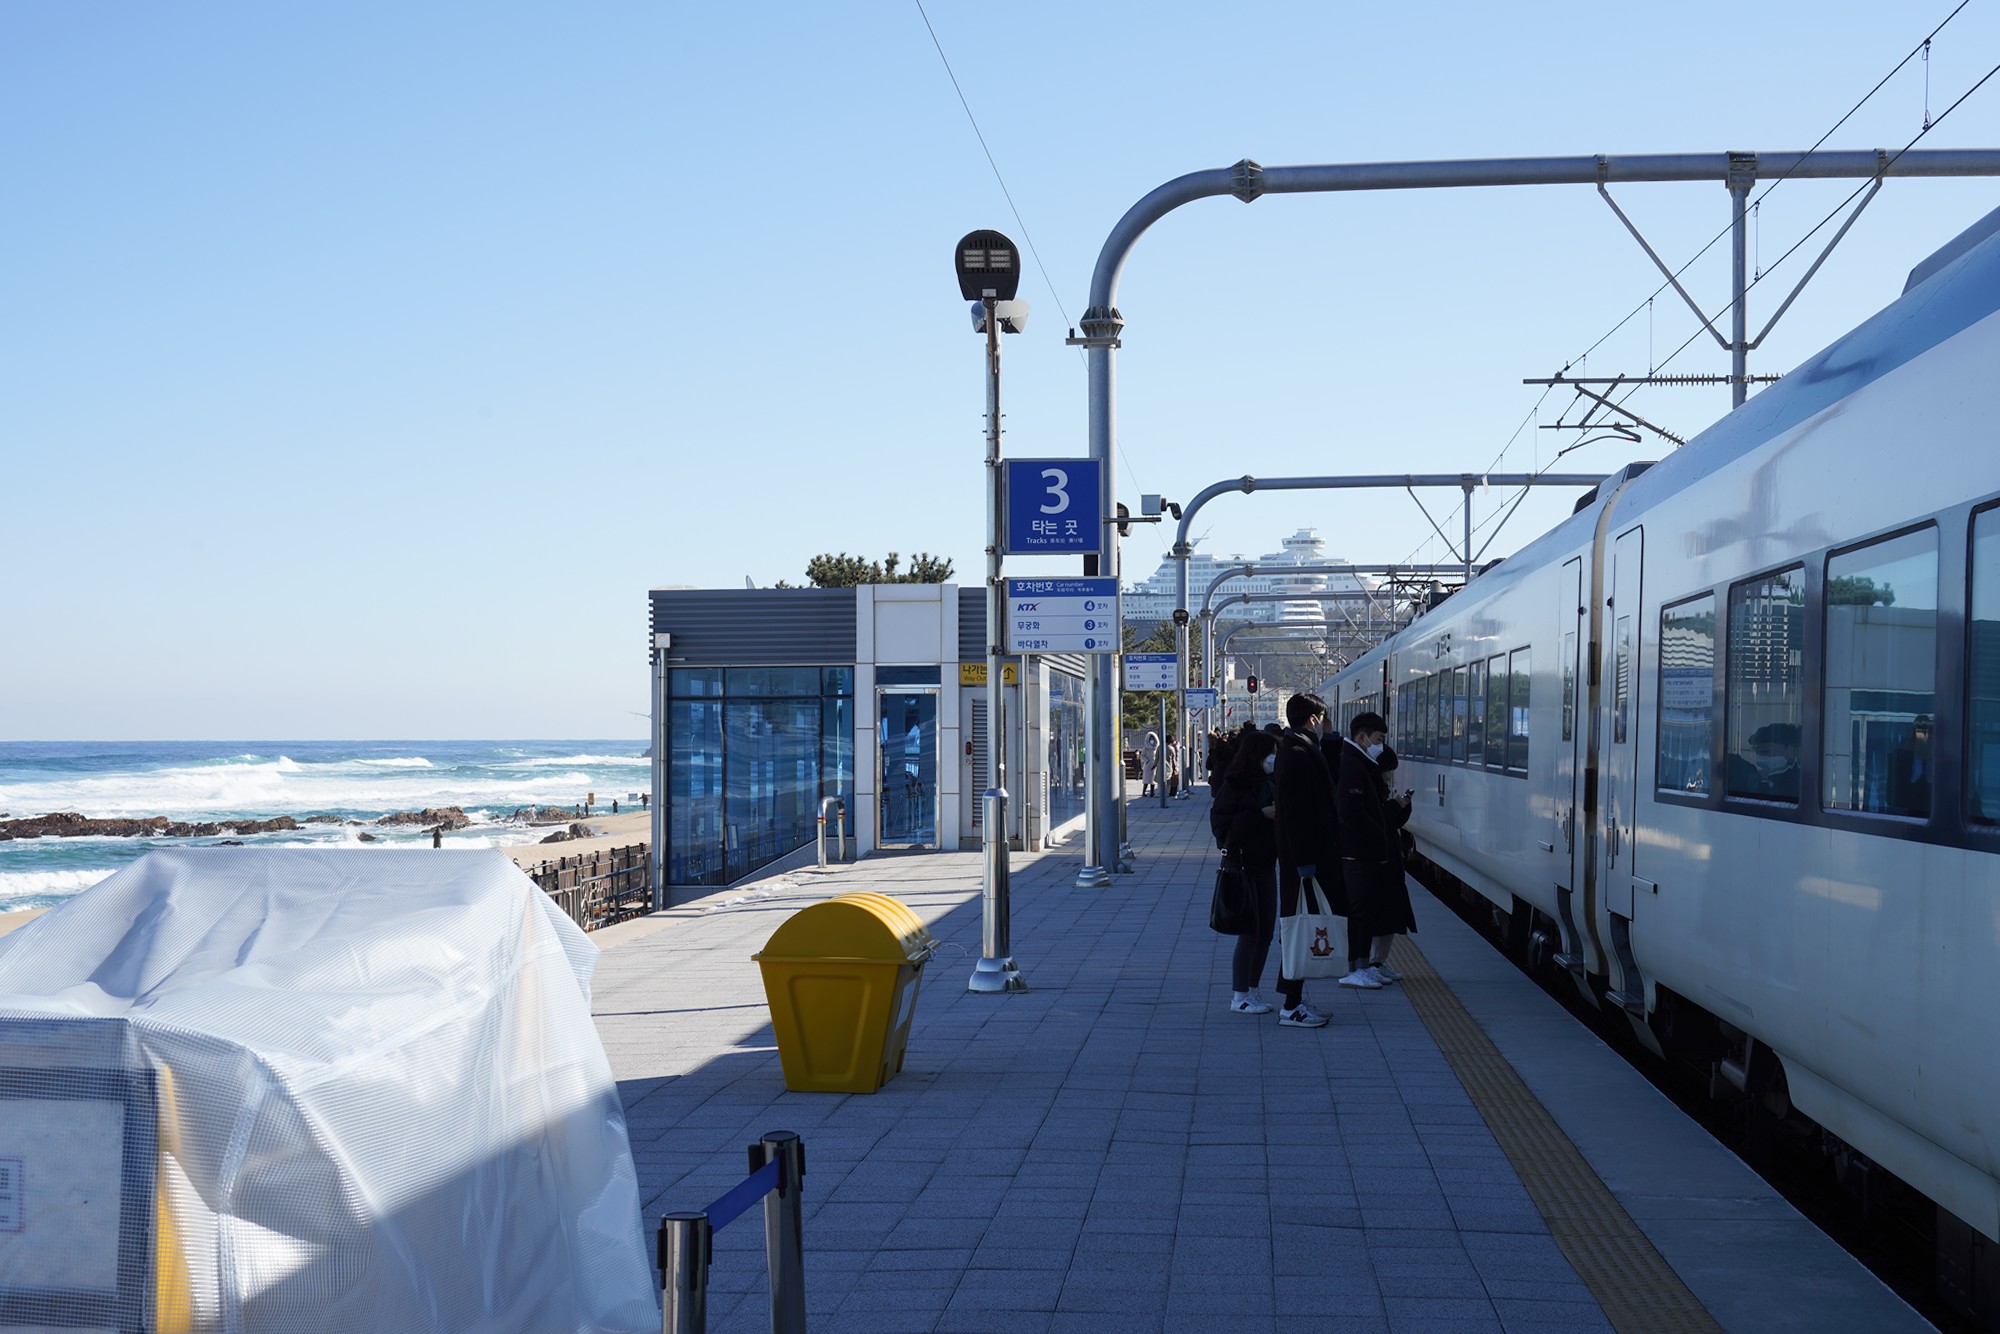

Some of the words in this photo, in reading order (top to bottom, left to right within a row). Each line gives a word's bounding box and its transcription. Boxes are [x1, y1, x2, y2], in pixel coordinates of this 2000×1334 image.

[1040, 468, 1070, 514] 3
[1032, 520, 1057, 535] 타는
[1065, 520, 1077, 535] 곳
[1016, 582, 1054, 592] 호차번호
[1017, 603, 1040, 611] KTX
[1018, 621, 1040, 630] 무궁화
[1017, 640, 1048, 649] 바다열차
